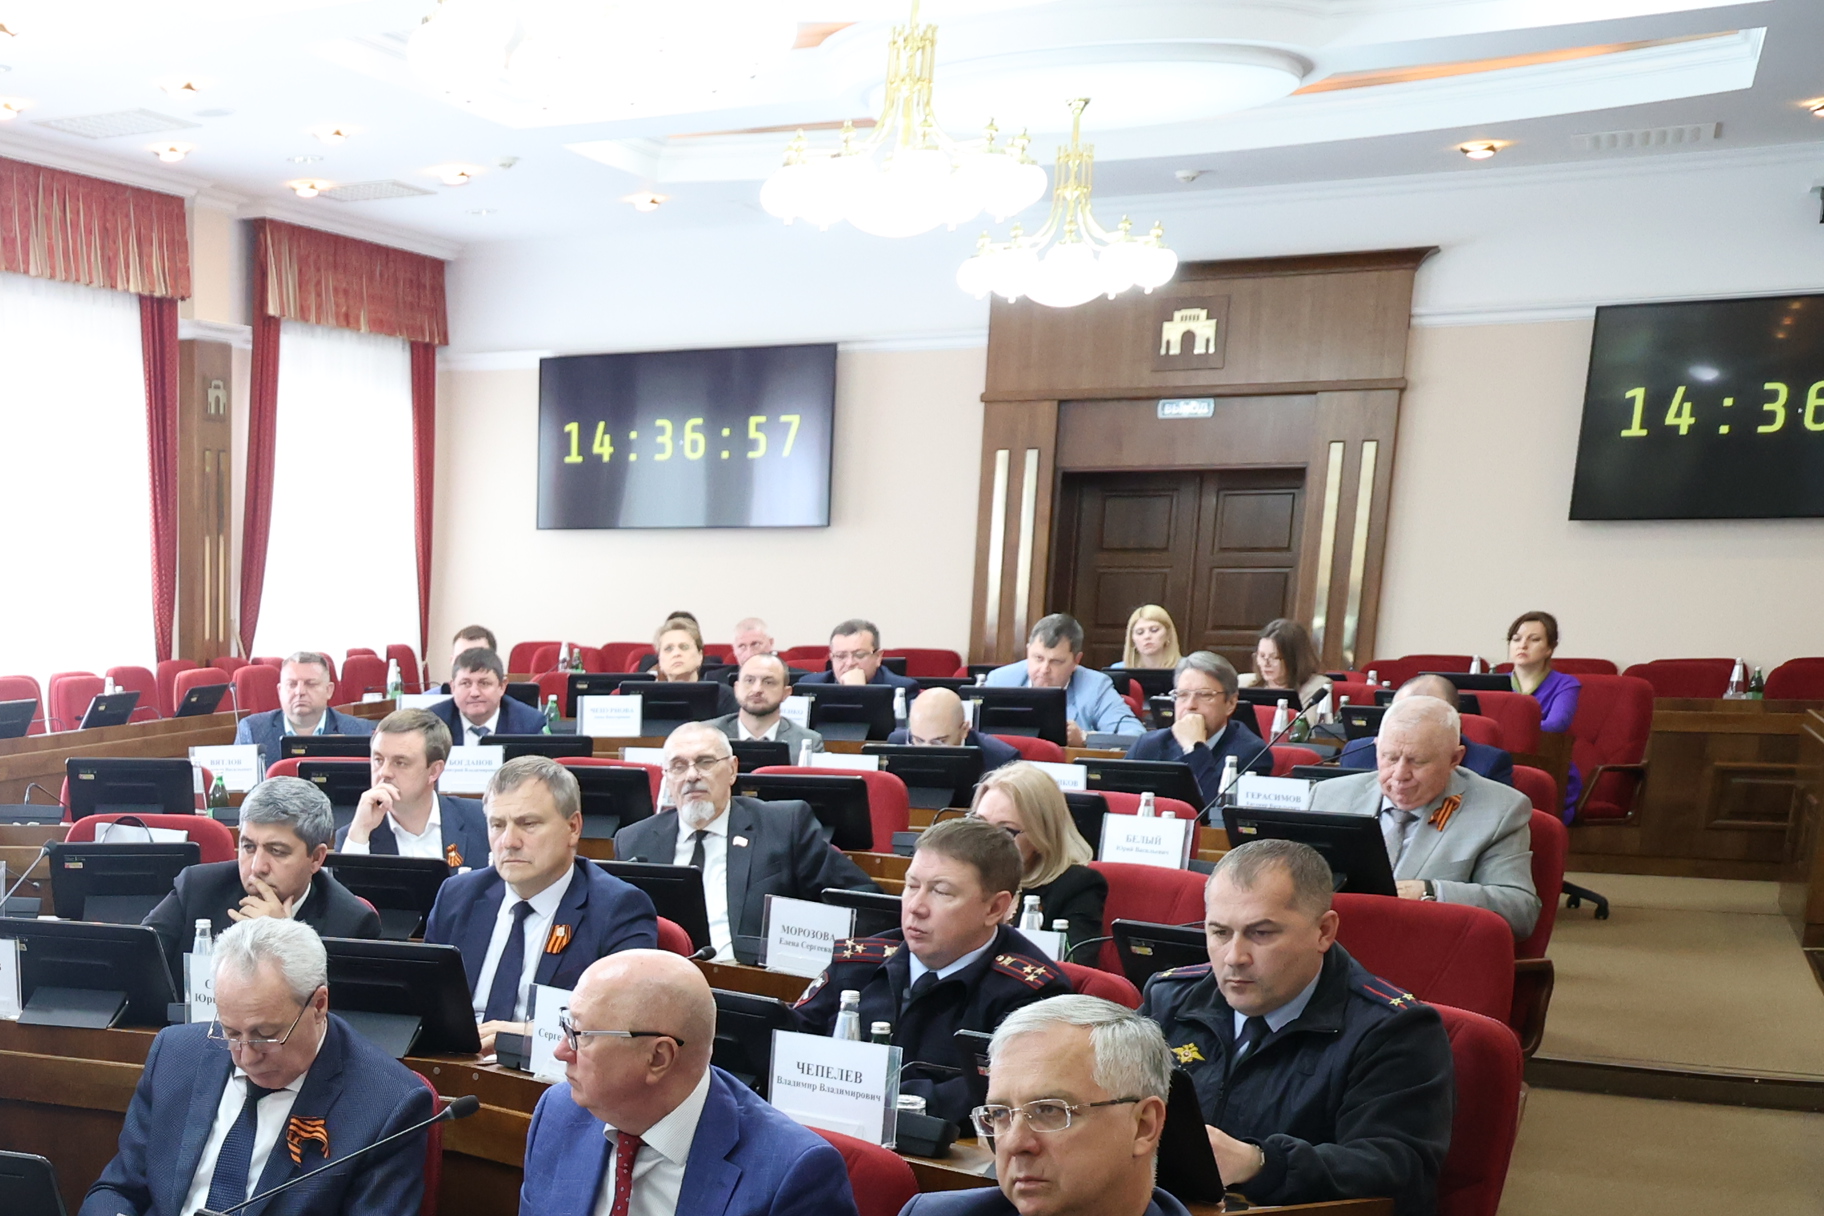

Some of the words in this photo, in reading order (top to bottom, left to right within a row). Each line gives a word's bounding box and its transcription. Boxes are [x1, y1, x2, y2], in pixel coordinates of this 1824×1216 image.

[563, 414, 801, 464] 14:36:57
[1246, 791, 1302, 803] ГЕРАСИМОВ
[1125, 834, 1162, 846] БЕЛЫЙ
[780, 924, 836, 941] МОРОЗОВА
[778, 937, 800, 948] Елена
[800, 941, 834, 953] Сергеевн
[796, 1061, 863, 1084] ЧЕПЕЛЕВ
[776, 1075, 817, 1092] Владимир
[819, 1083, 881, 1102] Владимирович
